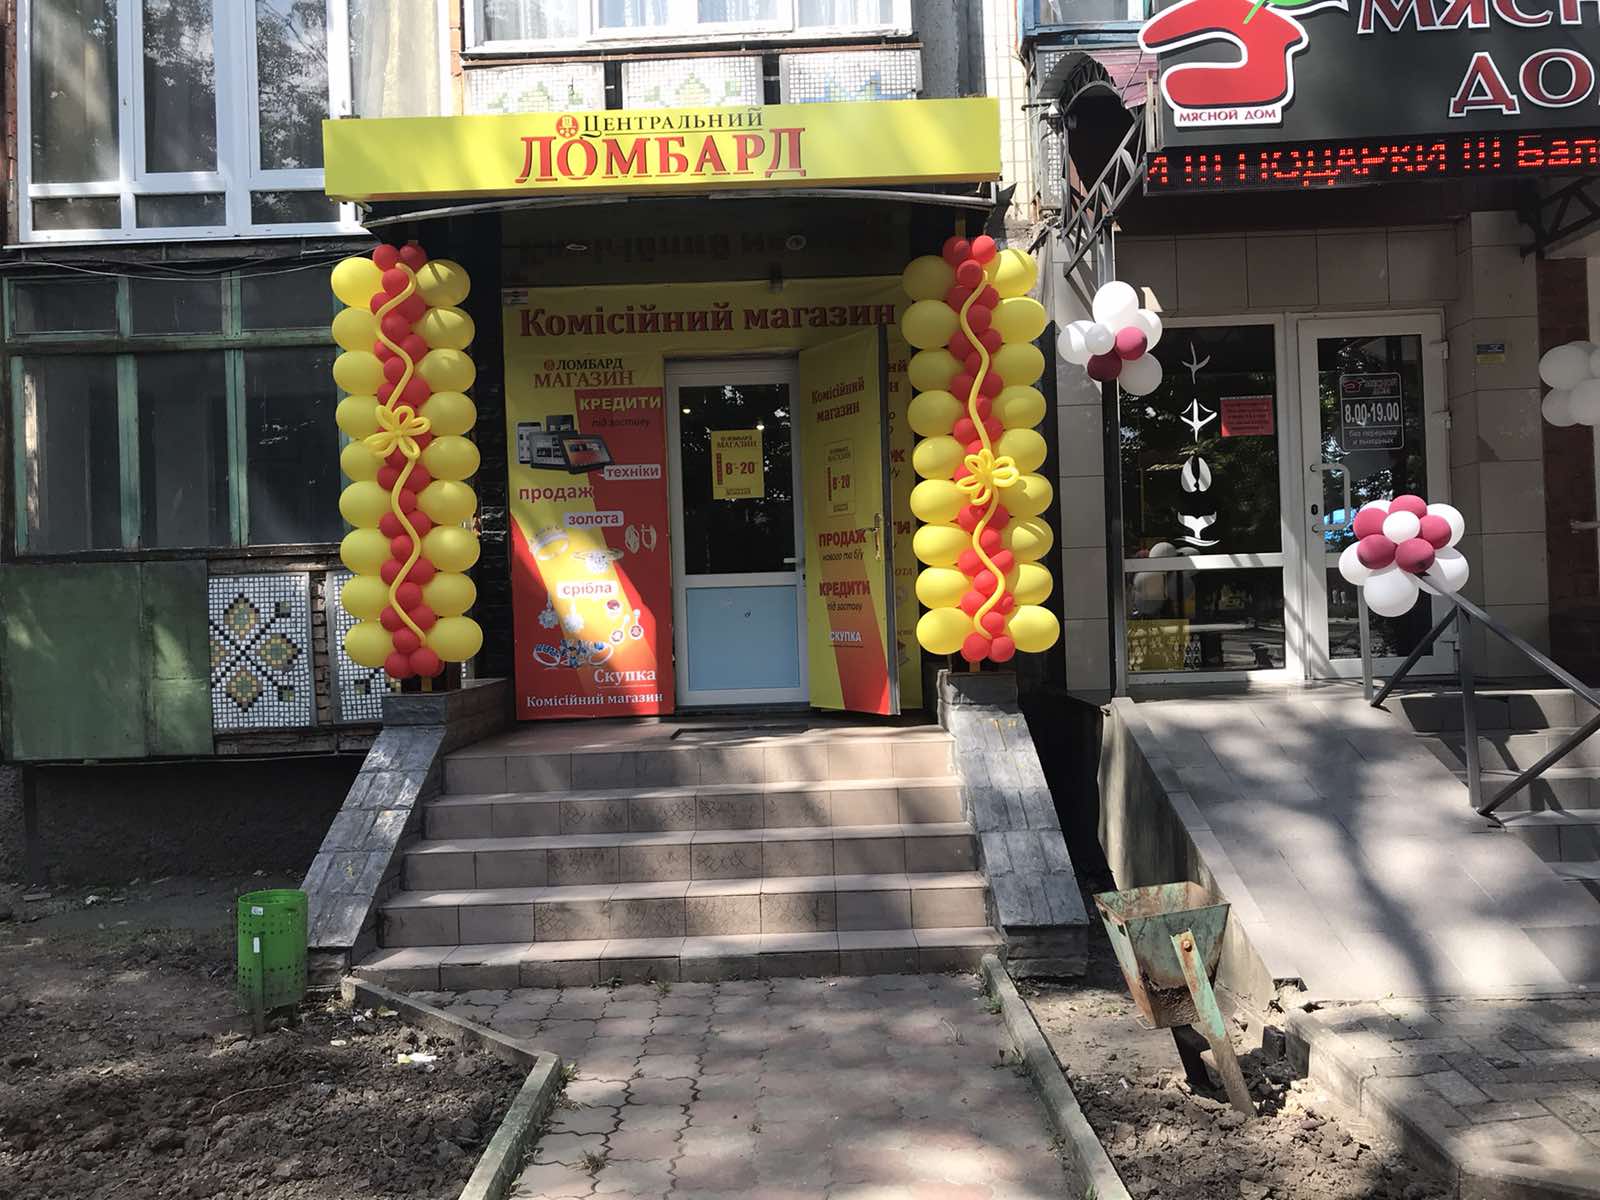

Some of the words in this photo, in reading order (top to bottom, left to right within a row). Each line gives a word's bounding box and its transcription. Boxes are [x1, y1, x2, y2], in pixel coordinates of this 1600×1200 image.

[1449, 48, 1600, 117] ДО
[580, 107, 763, 138] ЦЕНТРАЛЬНИЙ
[1179, 109, 1239, 122] МЯСНОЙ
[1244, 109, 1277, 120] ДОМ
[515, 127, 806, 184] ЛОМБАРД
[1239, 143, 1446, 187] ПОДАРКИ
[1518, 135, 1600, 167] Бал
[519, 302, 733, 337] Комісійний
[744, 302, 896, 331] магазин
[556, 358, 624, 371] ЛОМБАРД
[534, 370, 633, 389] МАГАЗИН
[811, 376, 865, 404] Комісійний
[579, 396, 662, 412] КРЕДИТИ
[816, 400, 860, 423] магазин
[606, 465, 660, 479] техніки
[519, 486, 593, 503] продаж
[568, 513, 619, 525] золота
[818, 528, 867, 548] ПРОДАЖ
[562, 582, 612, 596] срібла
[819, 580, 871, 599] КРЕДИТИ
[829, 631, 862, 642] СКУПКА
[593, 668, 657, 685] Скупка
[527, 693, 604, 708] Комісійний
[608, 692, 664, 705] магазин
